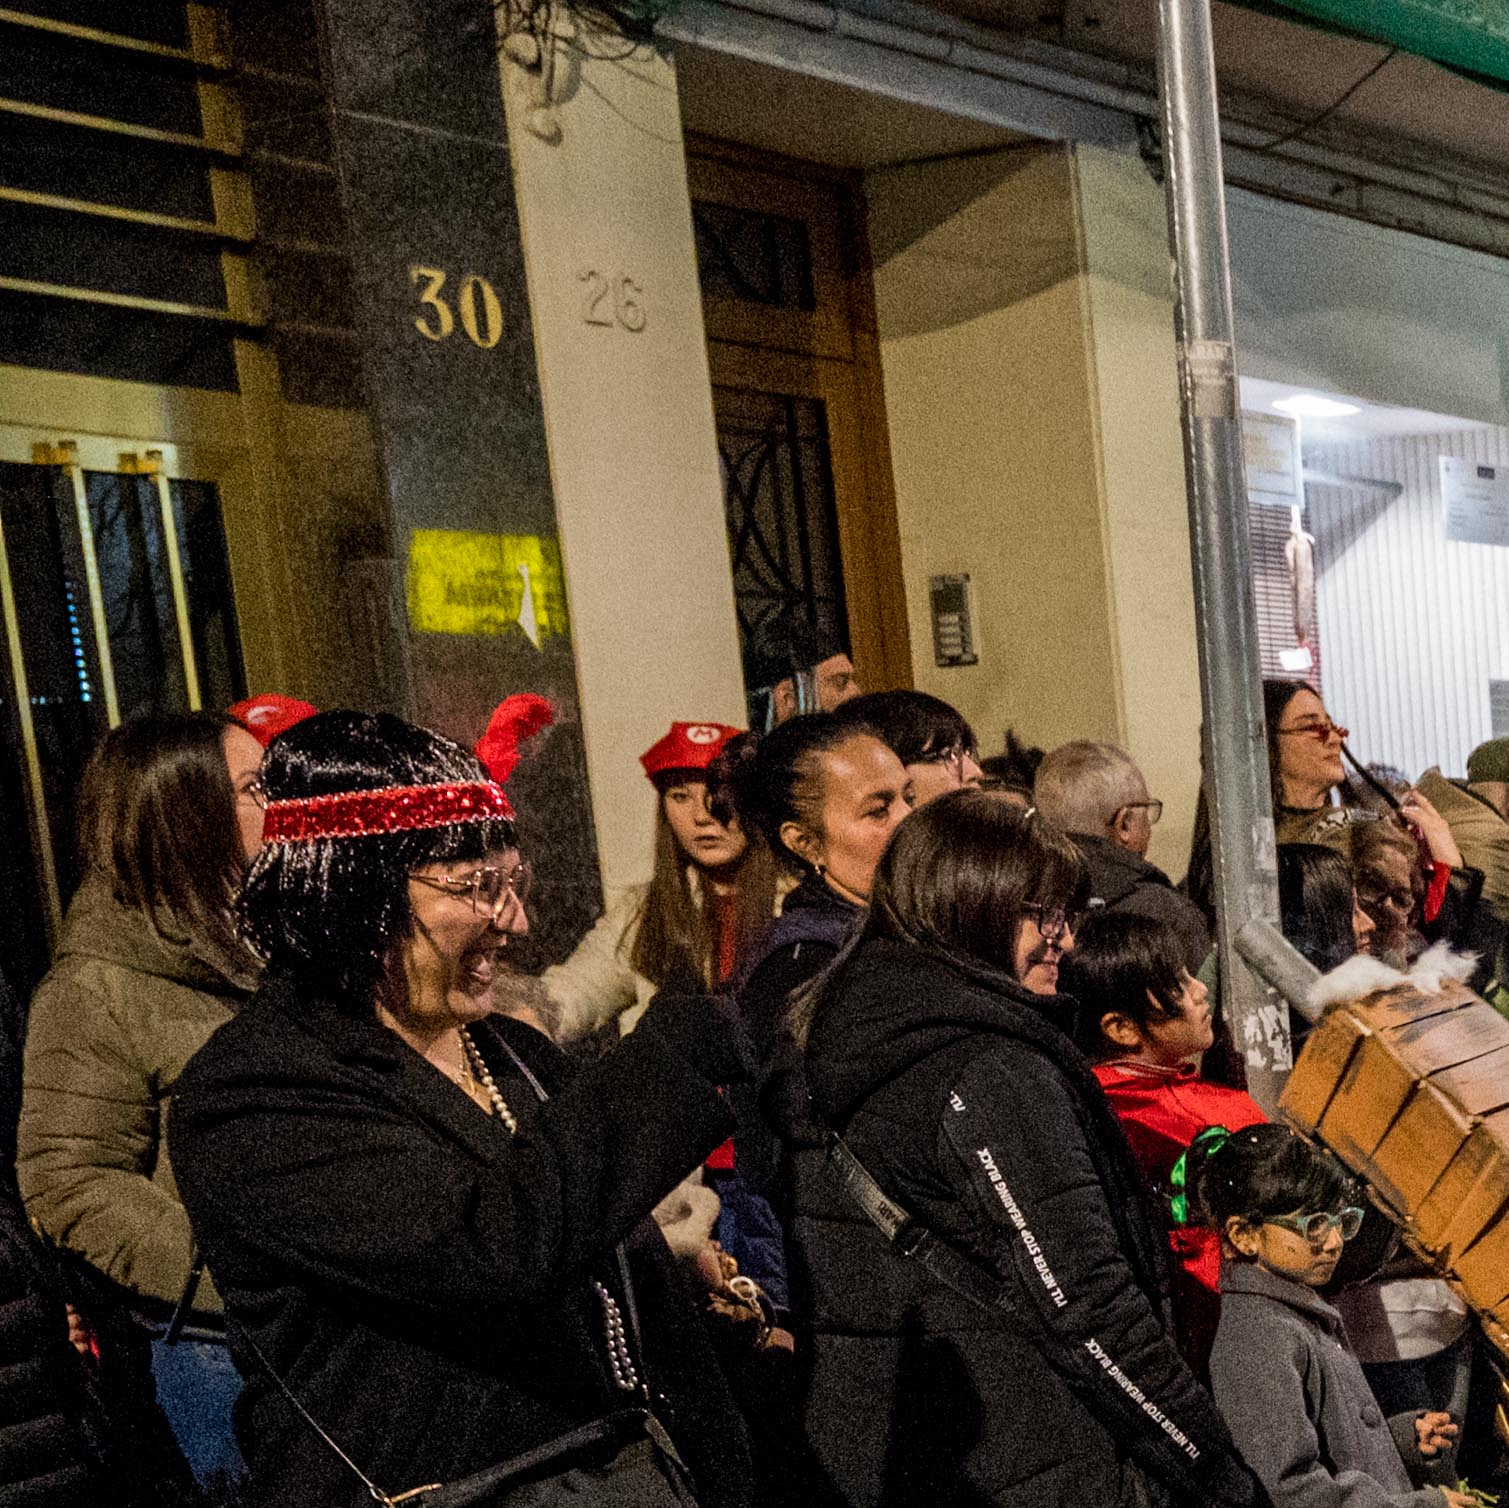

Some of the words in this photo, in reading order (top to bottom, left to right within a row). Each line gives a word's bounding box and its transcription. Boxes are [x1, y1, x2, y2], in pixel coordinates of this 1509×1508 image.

[409, 264, 504, 349] 30
[576, 268, 648, 334] 26
[693, 728, 714, 739] M
[976, 1146, 1003, 1184] BLACK
[994, 1181, 1027, 1231] WEARING
[1020, 1228, 1042, 1257] STOP
[1032, 1252, 1058, 1290] NEVER
[1050, 1286, 1068, 1309] I'LL
[1084, 1337, 1113, 1370] BLACK
[1107, 1365, 1147, 1405] WEARING
[1142, 1401, 1167, 1424] STOP
[1160, 1418, 1189, 1448] NEVER
